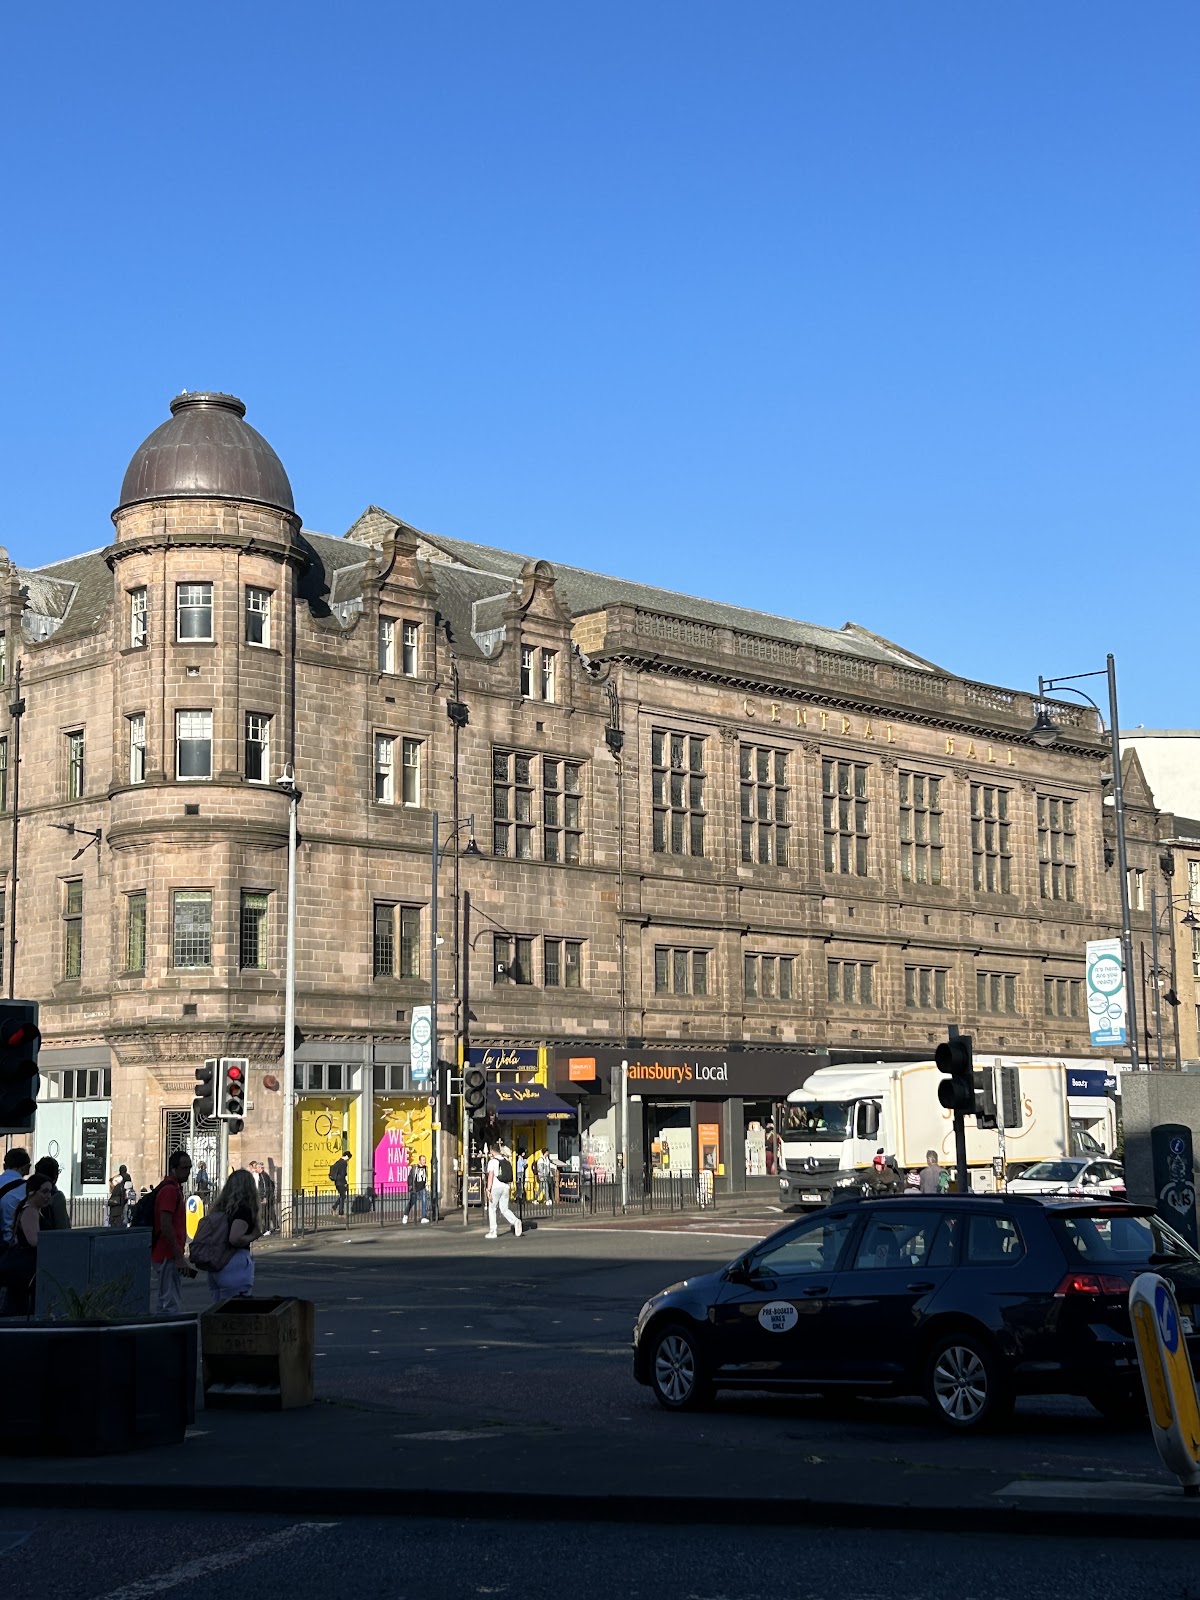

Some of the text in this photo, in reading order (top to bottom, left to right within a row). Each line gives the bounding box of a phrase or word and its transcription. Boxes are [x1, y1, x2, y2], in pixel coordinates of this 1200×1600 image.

[743, 699, 1015, 766] CENTRAL HALL
[495, 1050, 520, 1069] Viola
[626, 1062, 728, 1083] ainsbury's Local
[387, 1129, 404, 1145] WE
[387, 1148, 409, 1164] HAVE
[388, 1167, 395, 1182] A
[763, 1307, 793, 1315] PRE-BOOKED
